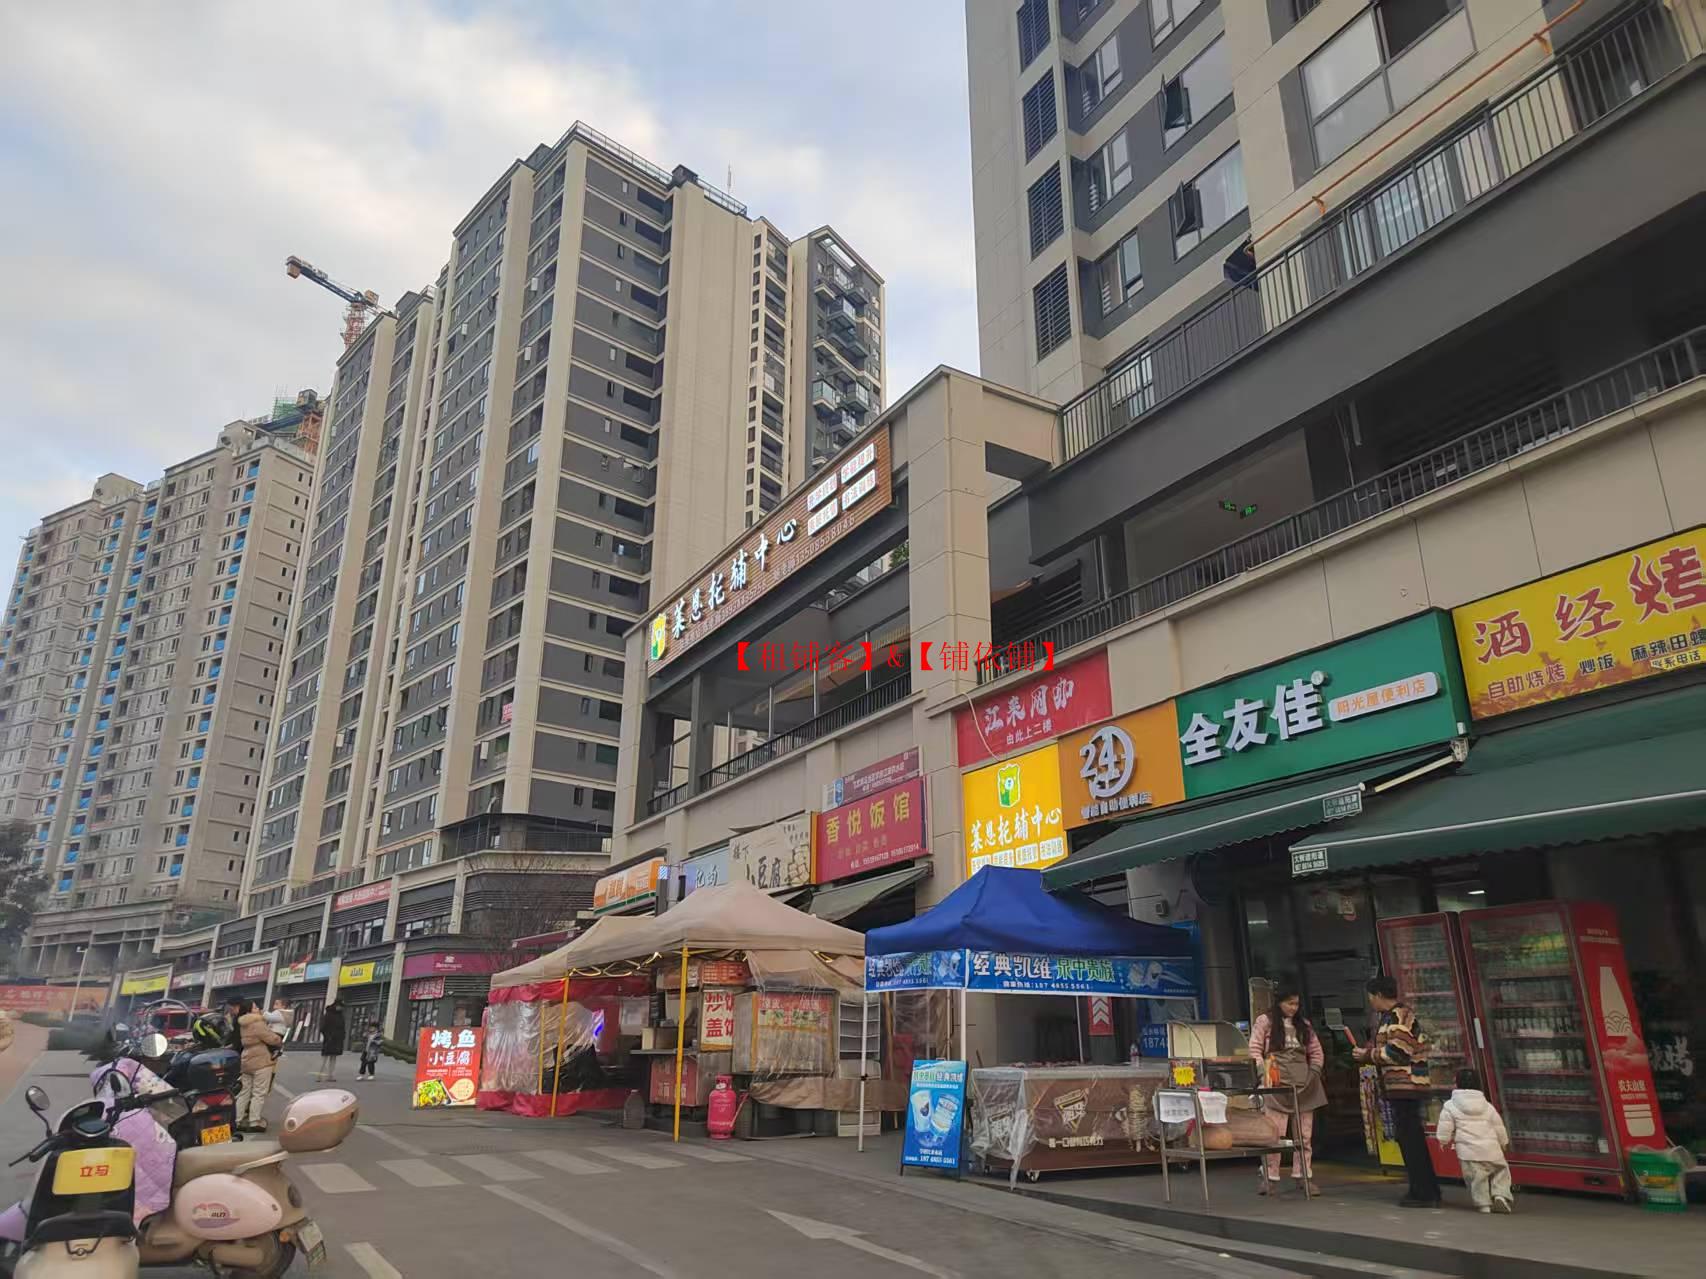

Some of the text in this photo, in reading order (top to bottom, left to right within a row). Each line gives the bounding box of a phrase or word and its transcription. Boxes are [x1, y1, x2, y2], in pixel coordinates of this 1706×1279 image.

[1475, 547, 1706, 664] 酒经烤
[1488, 664, 1566, 699] 自助烧烤
[1579, 653, 1615, 675] 炒饭
[1006, 718, 1053, 745] 由此上二楼
[1181, 678, 1324, 766] 全友佳
[826, 791, 910, 844] 香悦饭馆
[973, 951, 1050, 980] 经典凯维
[431, 1029, 476, 1049] 烤鱼
[429, 1050, 472, 1066] 小豆腐
